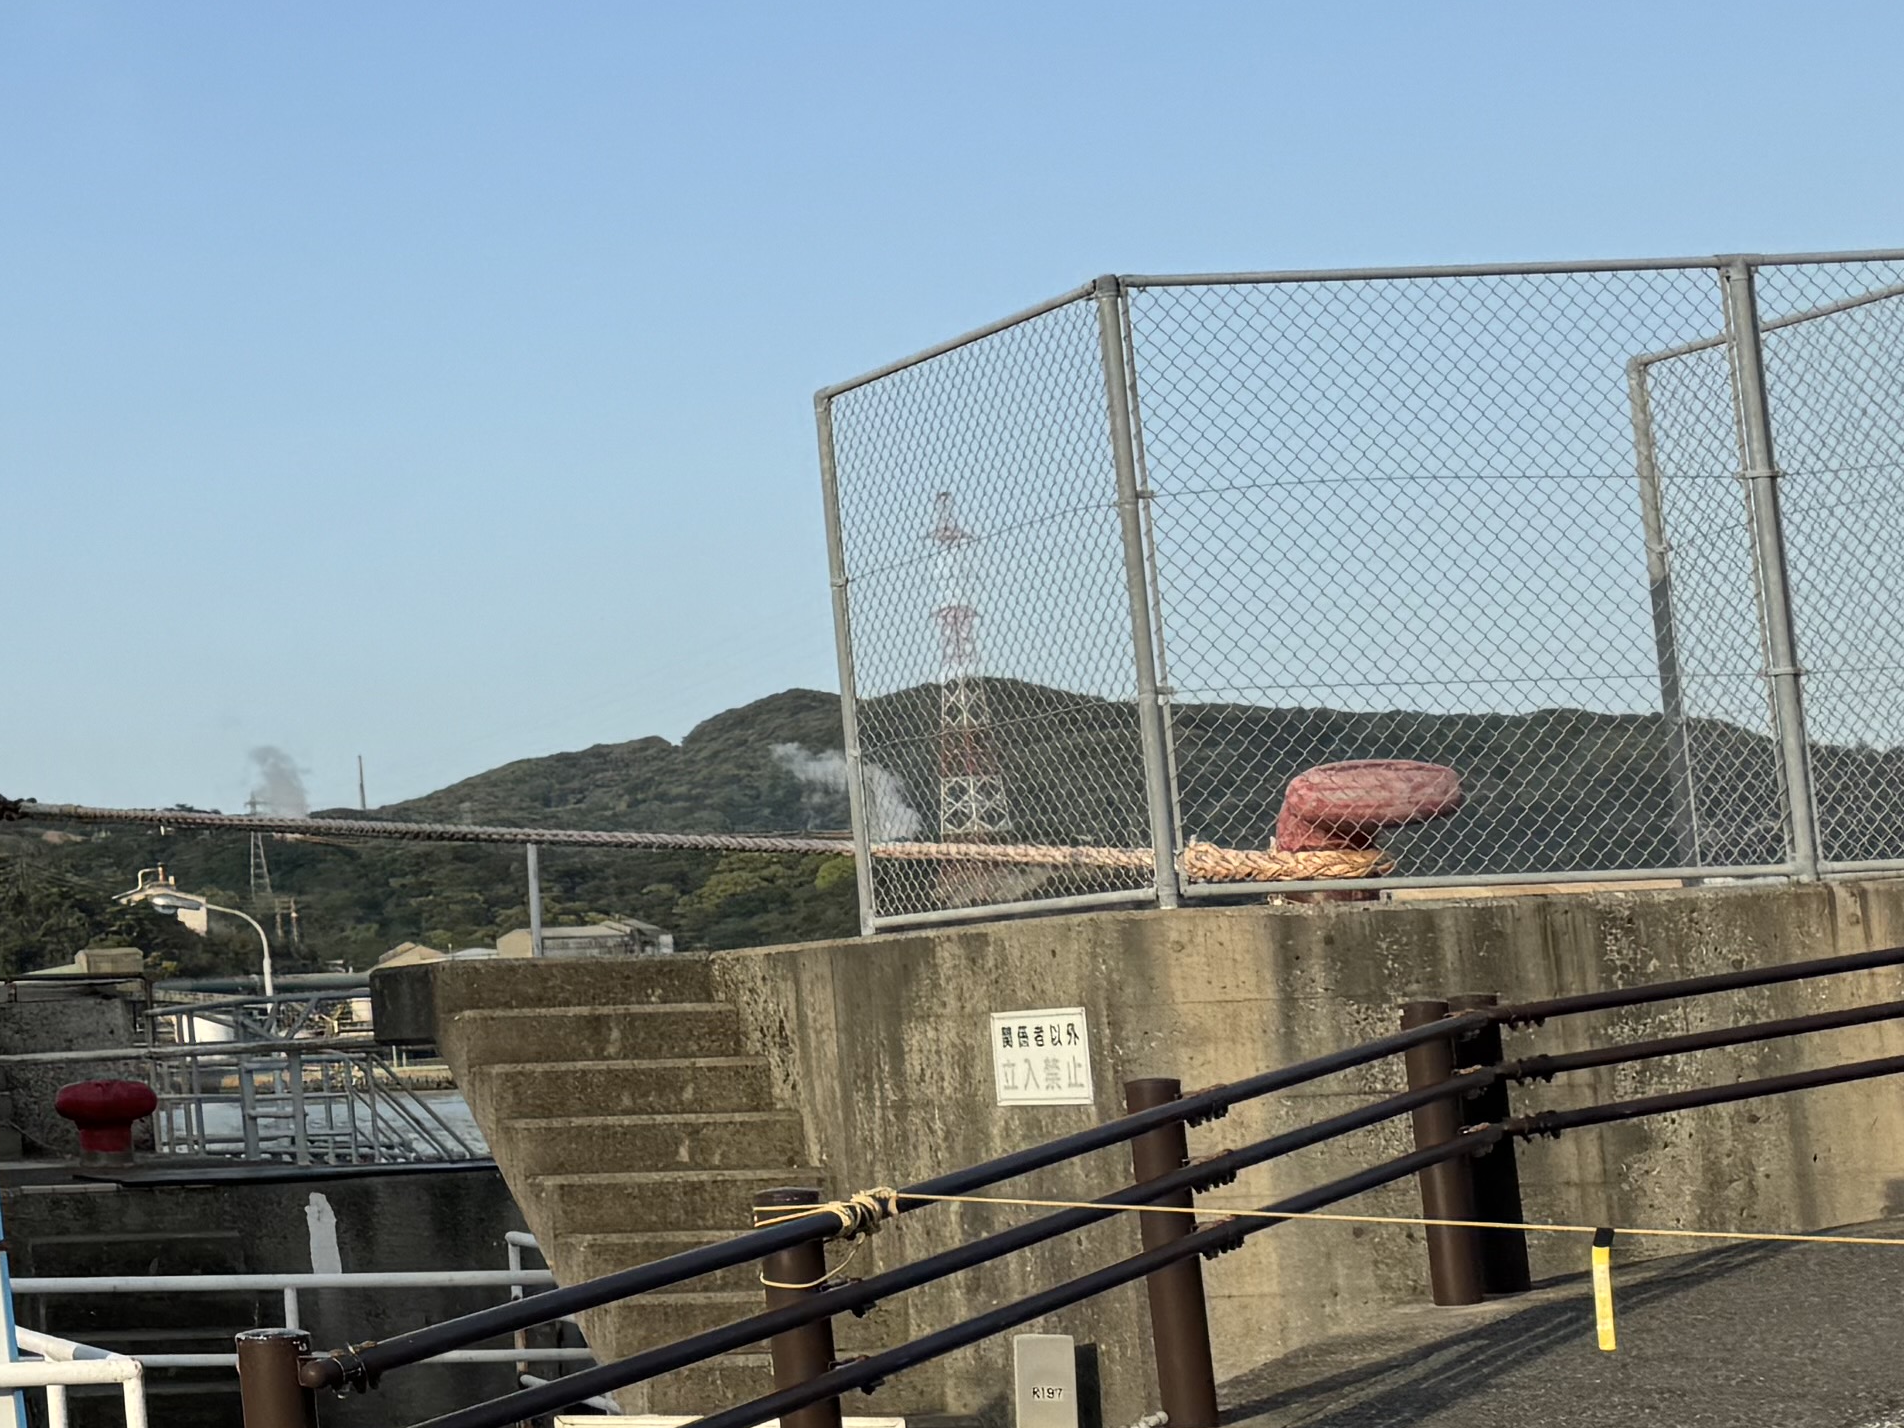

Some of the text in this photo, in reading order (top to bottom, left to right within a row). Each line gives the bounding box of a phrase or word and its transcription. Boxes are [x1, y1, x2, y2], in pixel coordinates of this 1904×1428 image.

[1002, 1055, 1085, 1091] 立入禁止
[1032, 1386, 1063, 1399] R197
